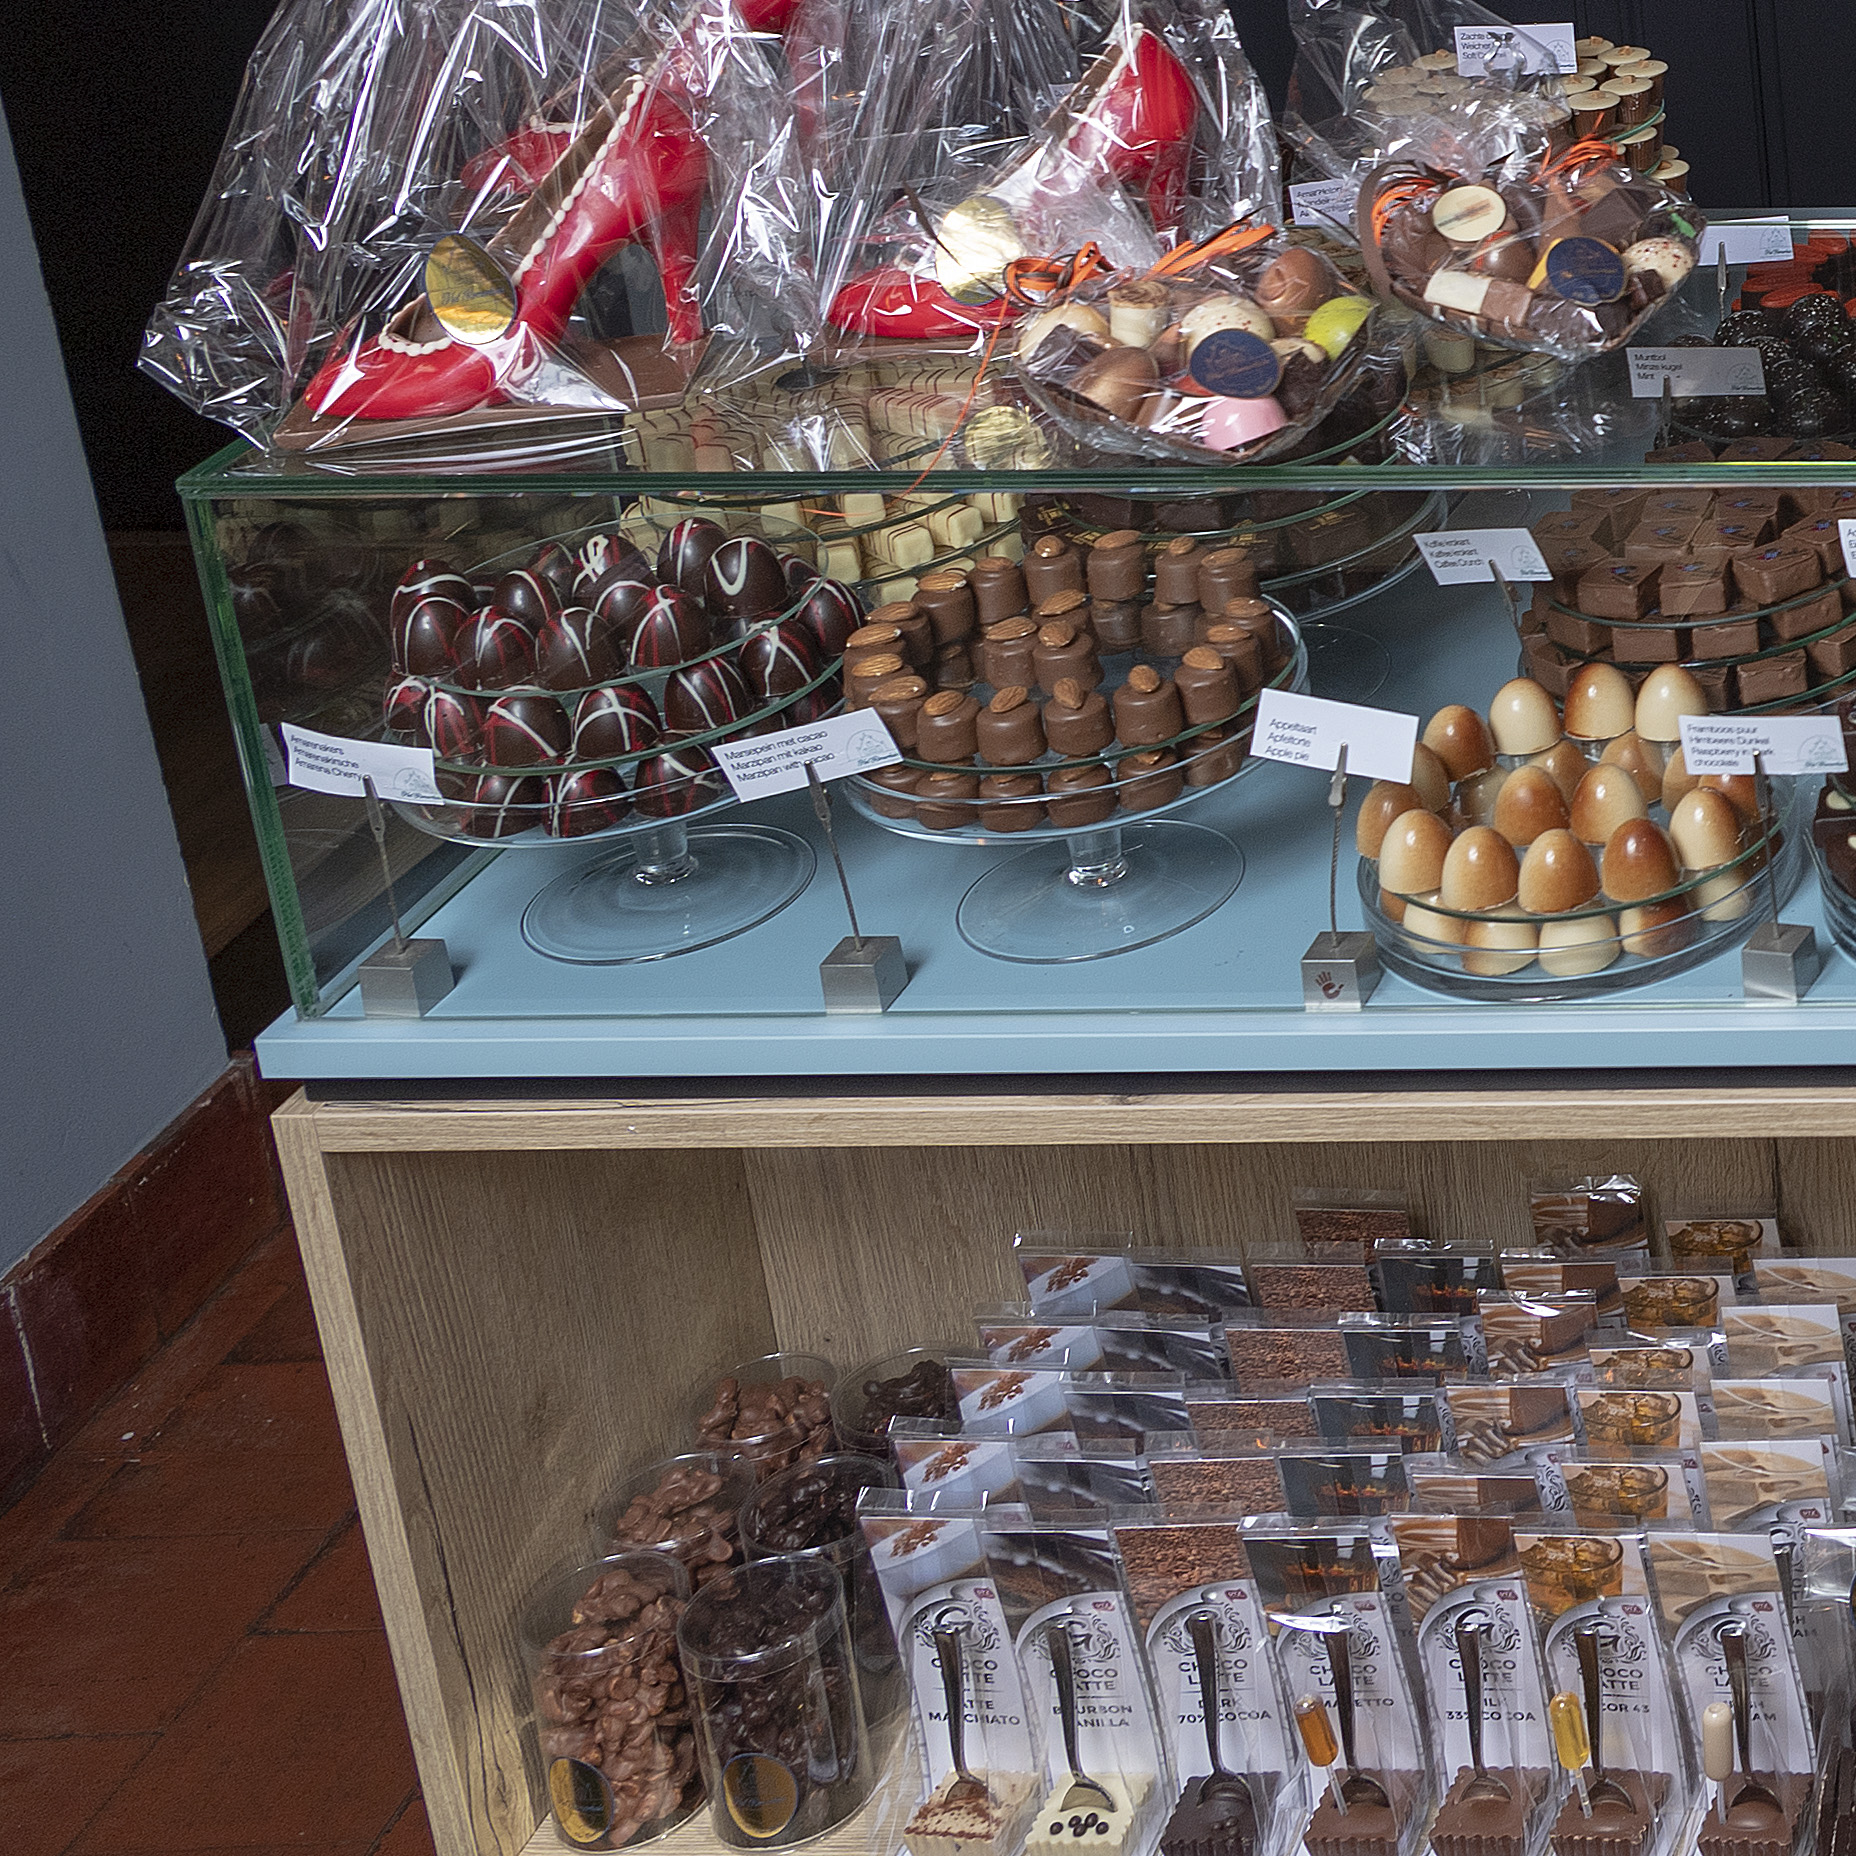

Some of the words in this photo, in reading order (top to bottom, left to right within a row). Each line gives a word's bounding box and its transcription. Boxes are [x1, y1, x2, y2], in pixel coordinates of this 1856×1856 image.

[1638, 372, 1655, 380] Mint
[1270, 717, 1318, 735] Appeltaart
[725, 743, 778, 761] Marsepein
[779, 738, 797, 748] met
[797, 731, 829, 745] cacao
[1265, 744, 1292, 759] Apple
[731, 755, 775, 773] Marzipan
[739, 766, 782, 784] Marzipan
[1053, 1705, 1133, 1718] BURBON
